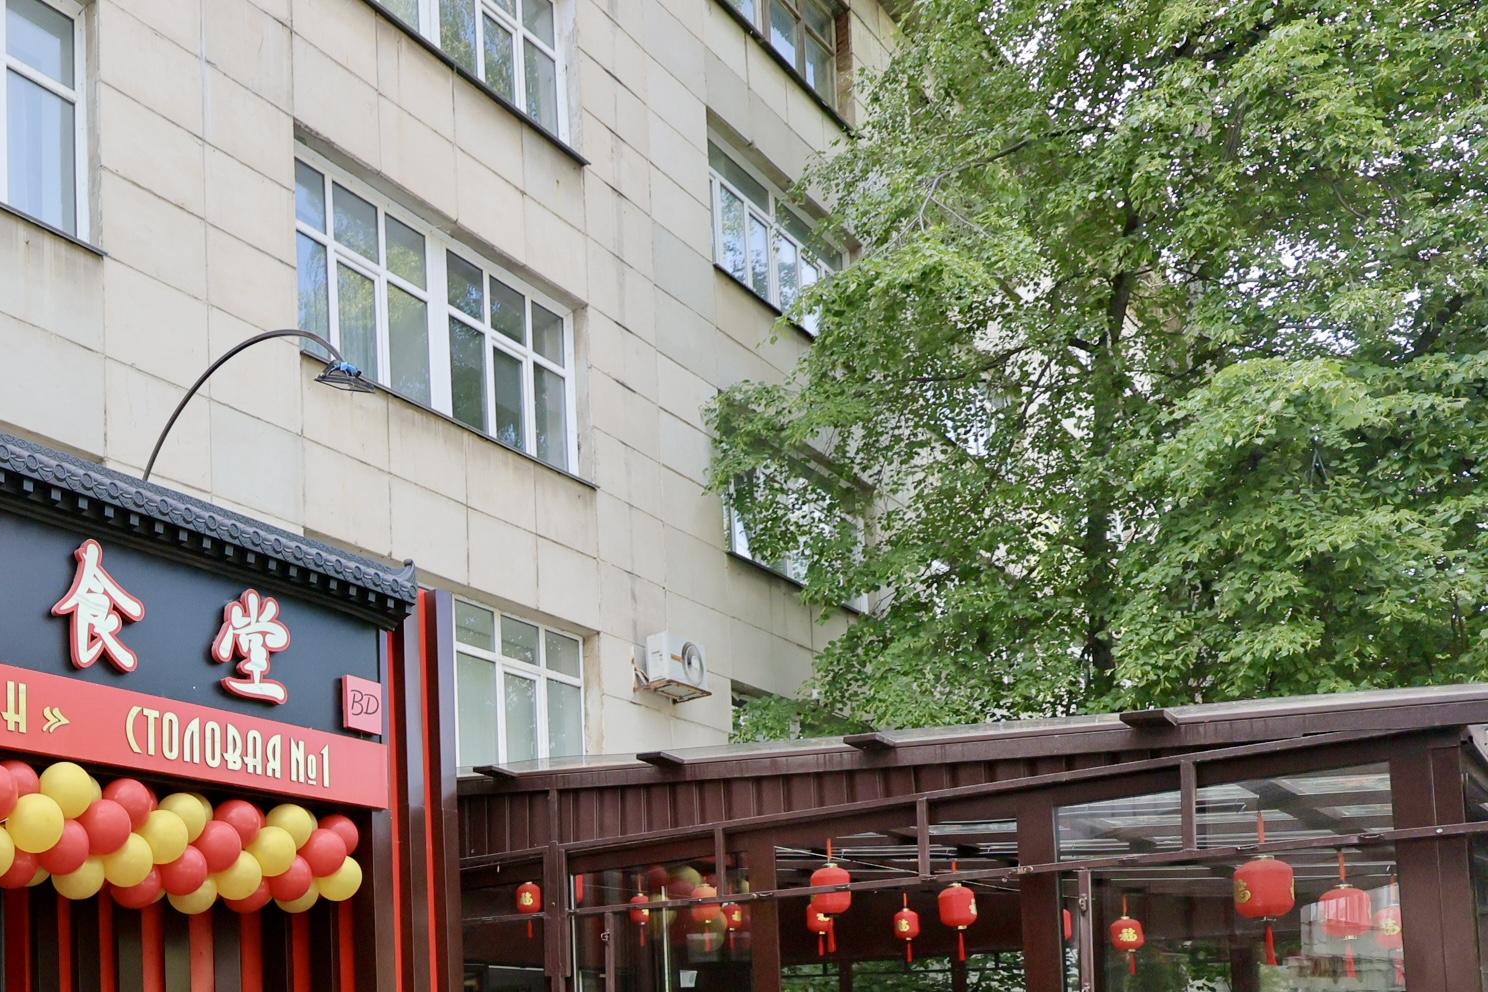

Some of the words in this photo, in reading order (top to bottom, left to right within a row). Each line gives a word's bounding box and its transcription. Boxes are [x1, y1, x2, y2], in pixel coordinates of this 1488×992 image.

[350, 689, 380, 716] BD
[125, 705, 281, 778] СТОЛОВАЯ
[290, 738, 332, 788] №1
